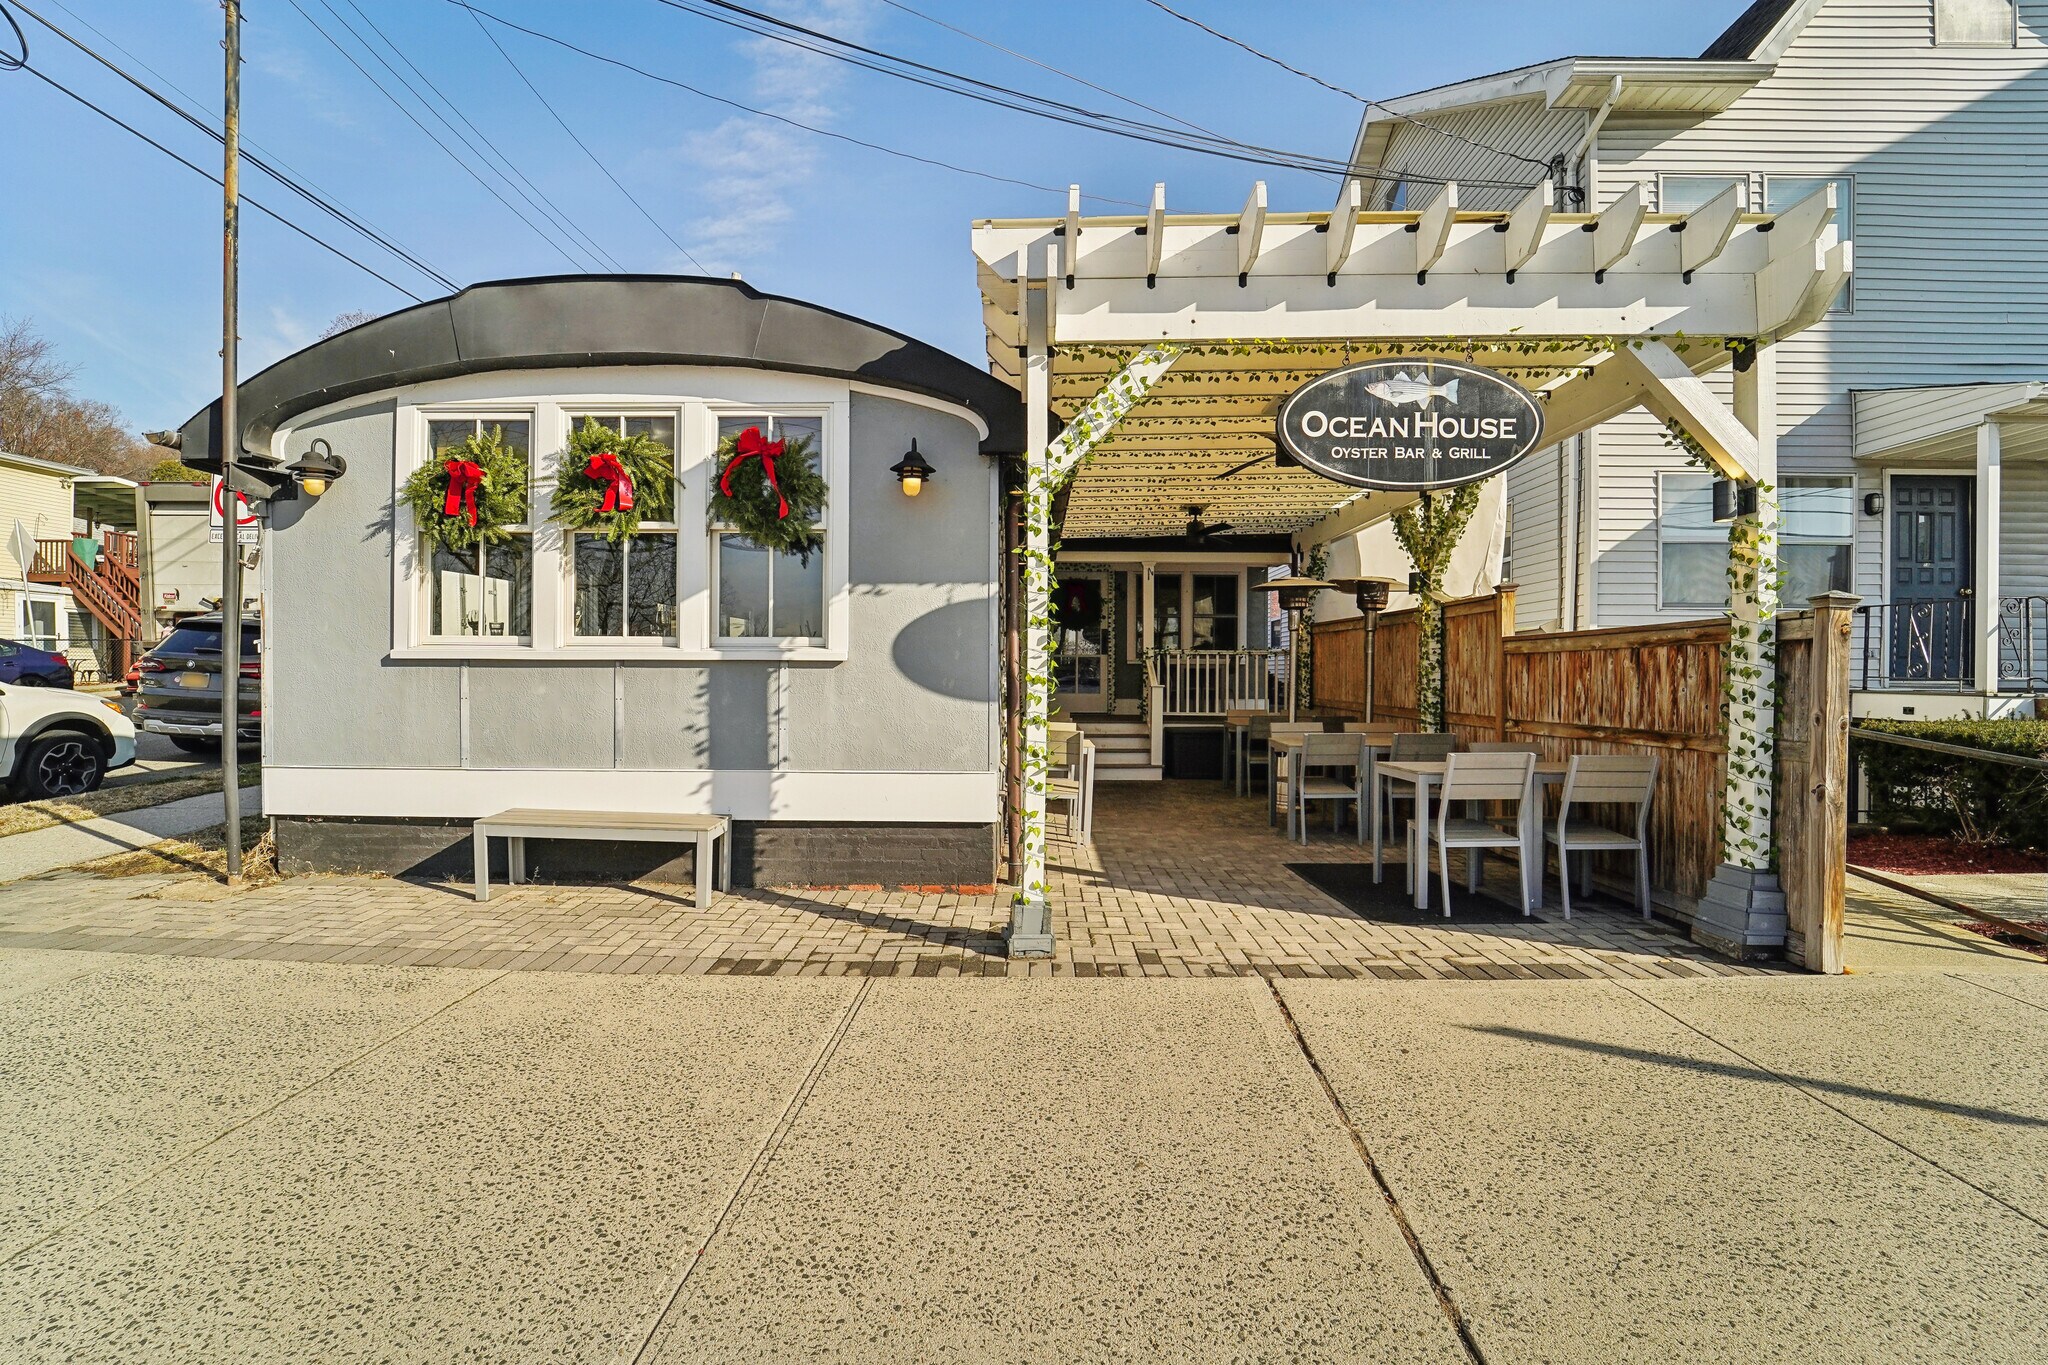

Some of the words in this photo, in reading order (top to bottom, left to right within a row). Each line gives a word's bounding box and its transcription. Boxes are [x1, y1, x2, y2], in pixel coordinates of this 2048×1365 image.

[1301, 410, 1408, 438] OCEAN
[1414, 411, 1517, 439] HOUSE
[1331, 446, 1388, 459] OYSTER
[1394, 446, 1425, 459] BAR
[1431, 447, 1442, 459] &
[1448, 446, 1491, 459] GRILL
